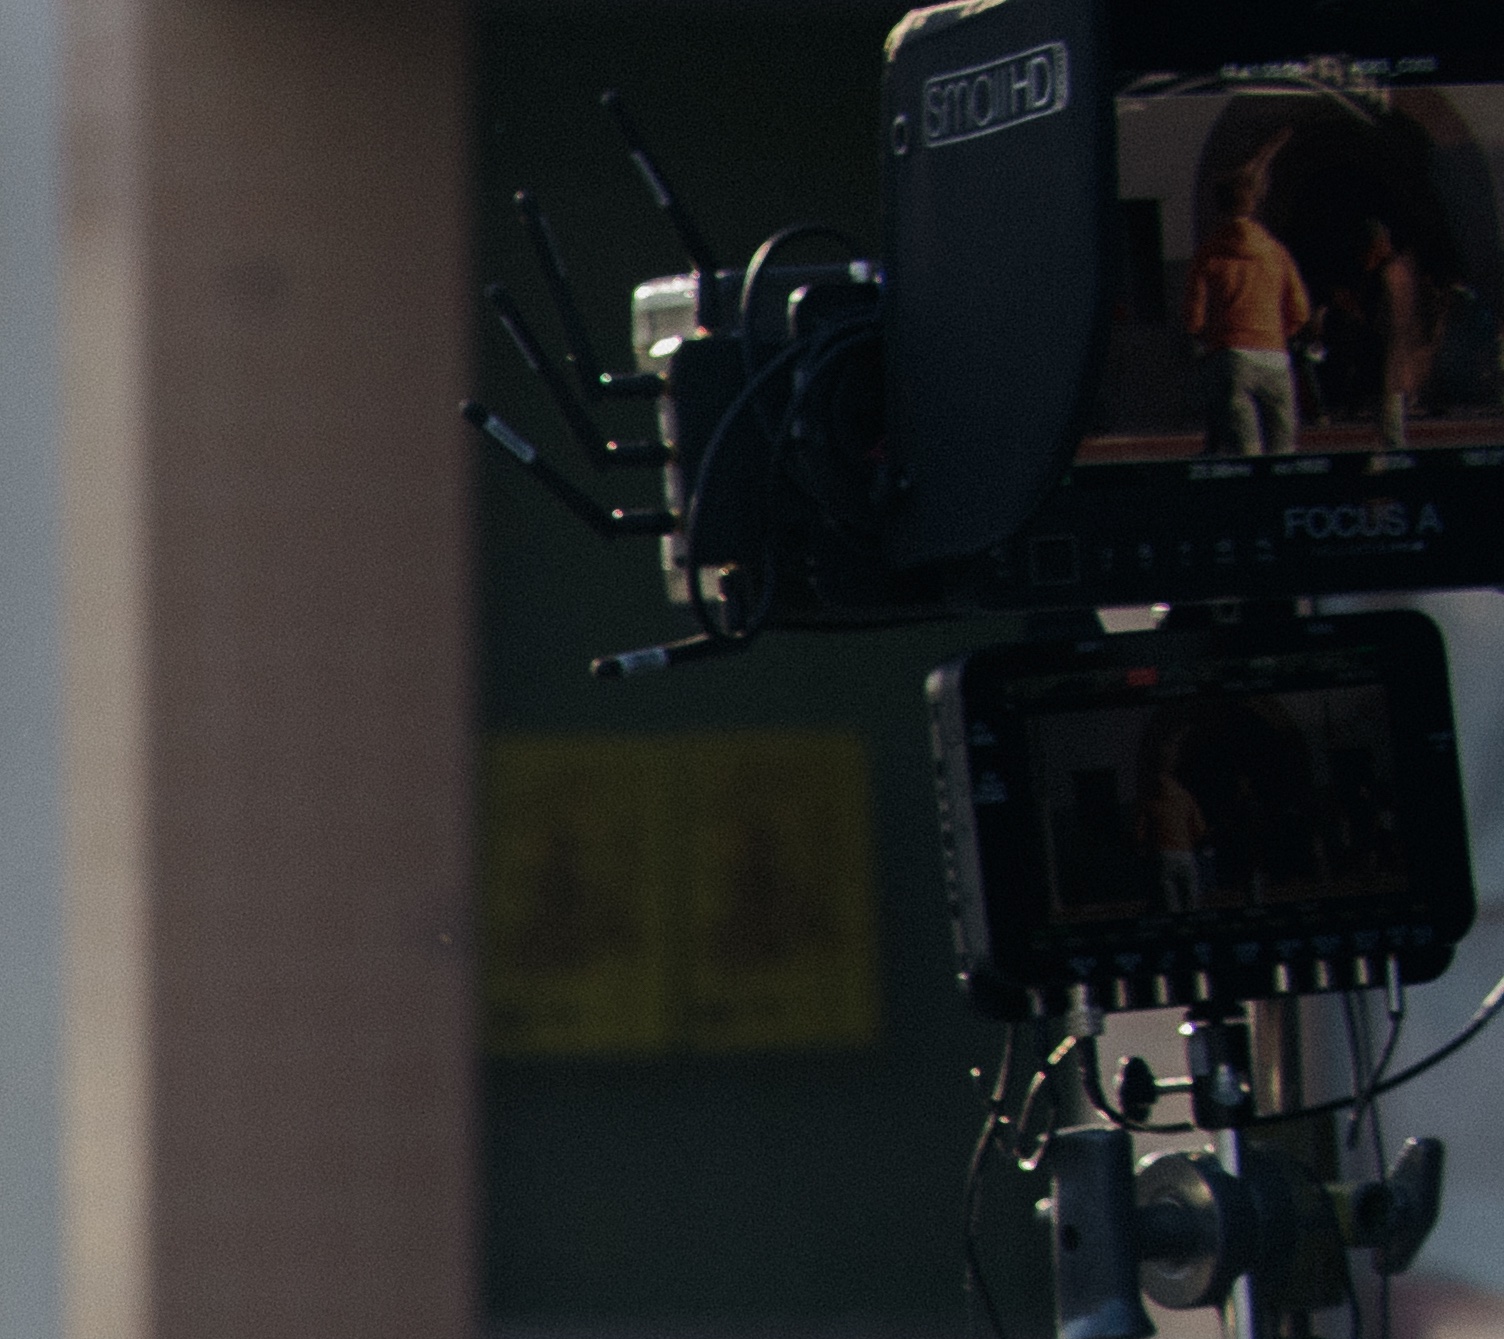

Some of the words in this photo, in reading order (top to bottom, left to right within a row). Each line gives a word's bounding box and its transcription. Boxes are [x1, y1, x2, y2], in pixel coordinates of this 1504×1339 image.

[926, 55, 1051, 138] smallHD
[1283, 500, 1410, 539] FOCUS
[1416, 500, 1445, 534] A
